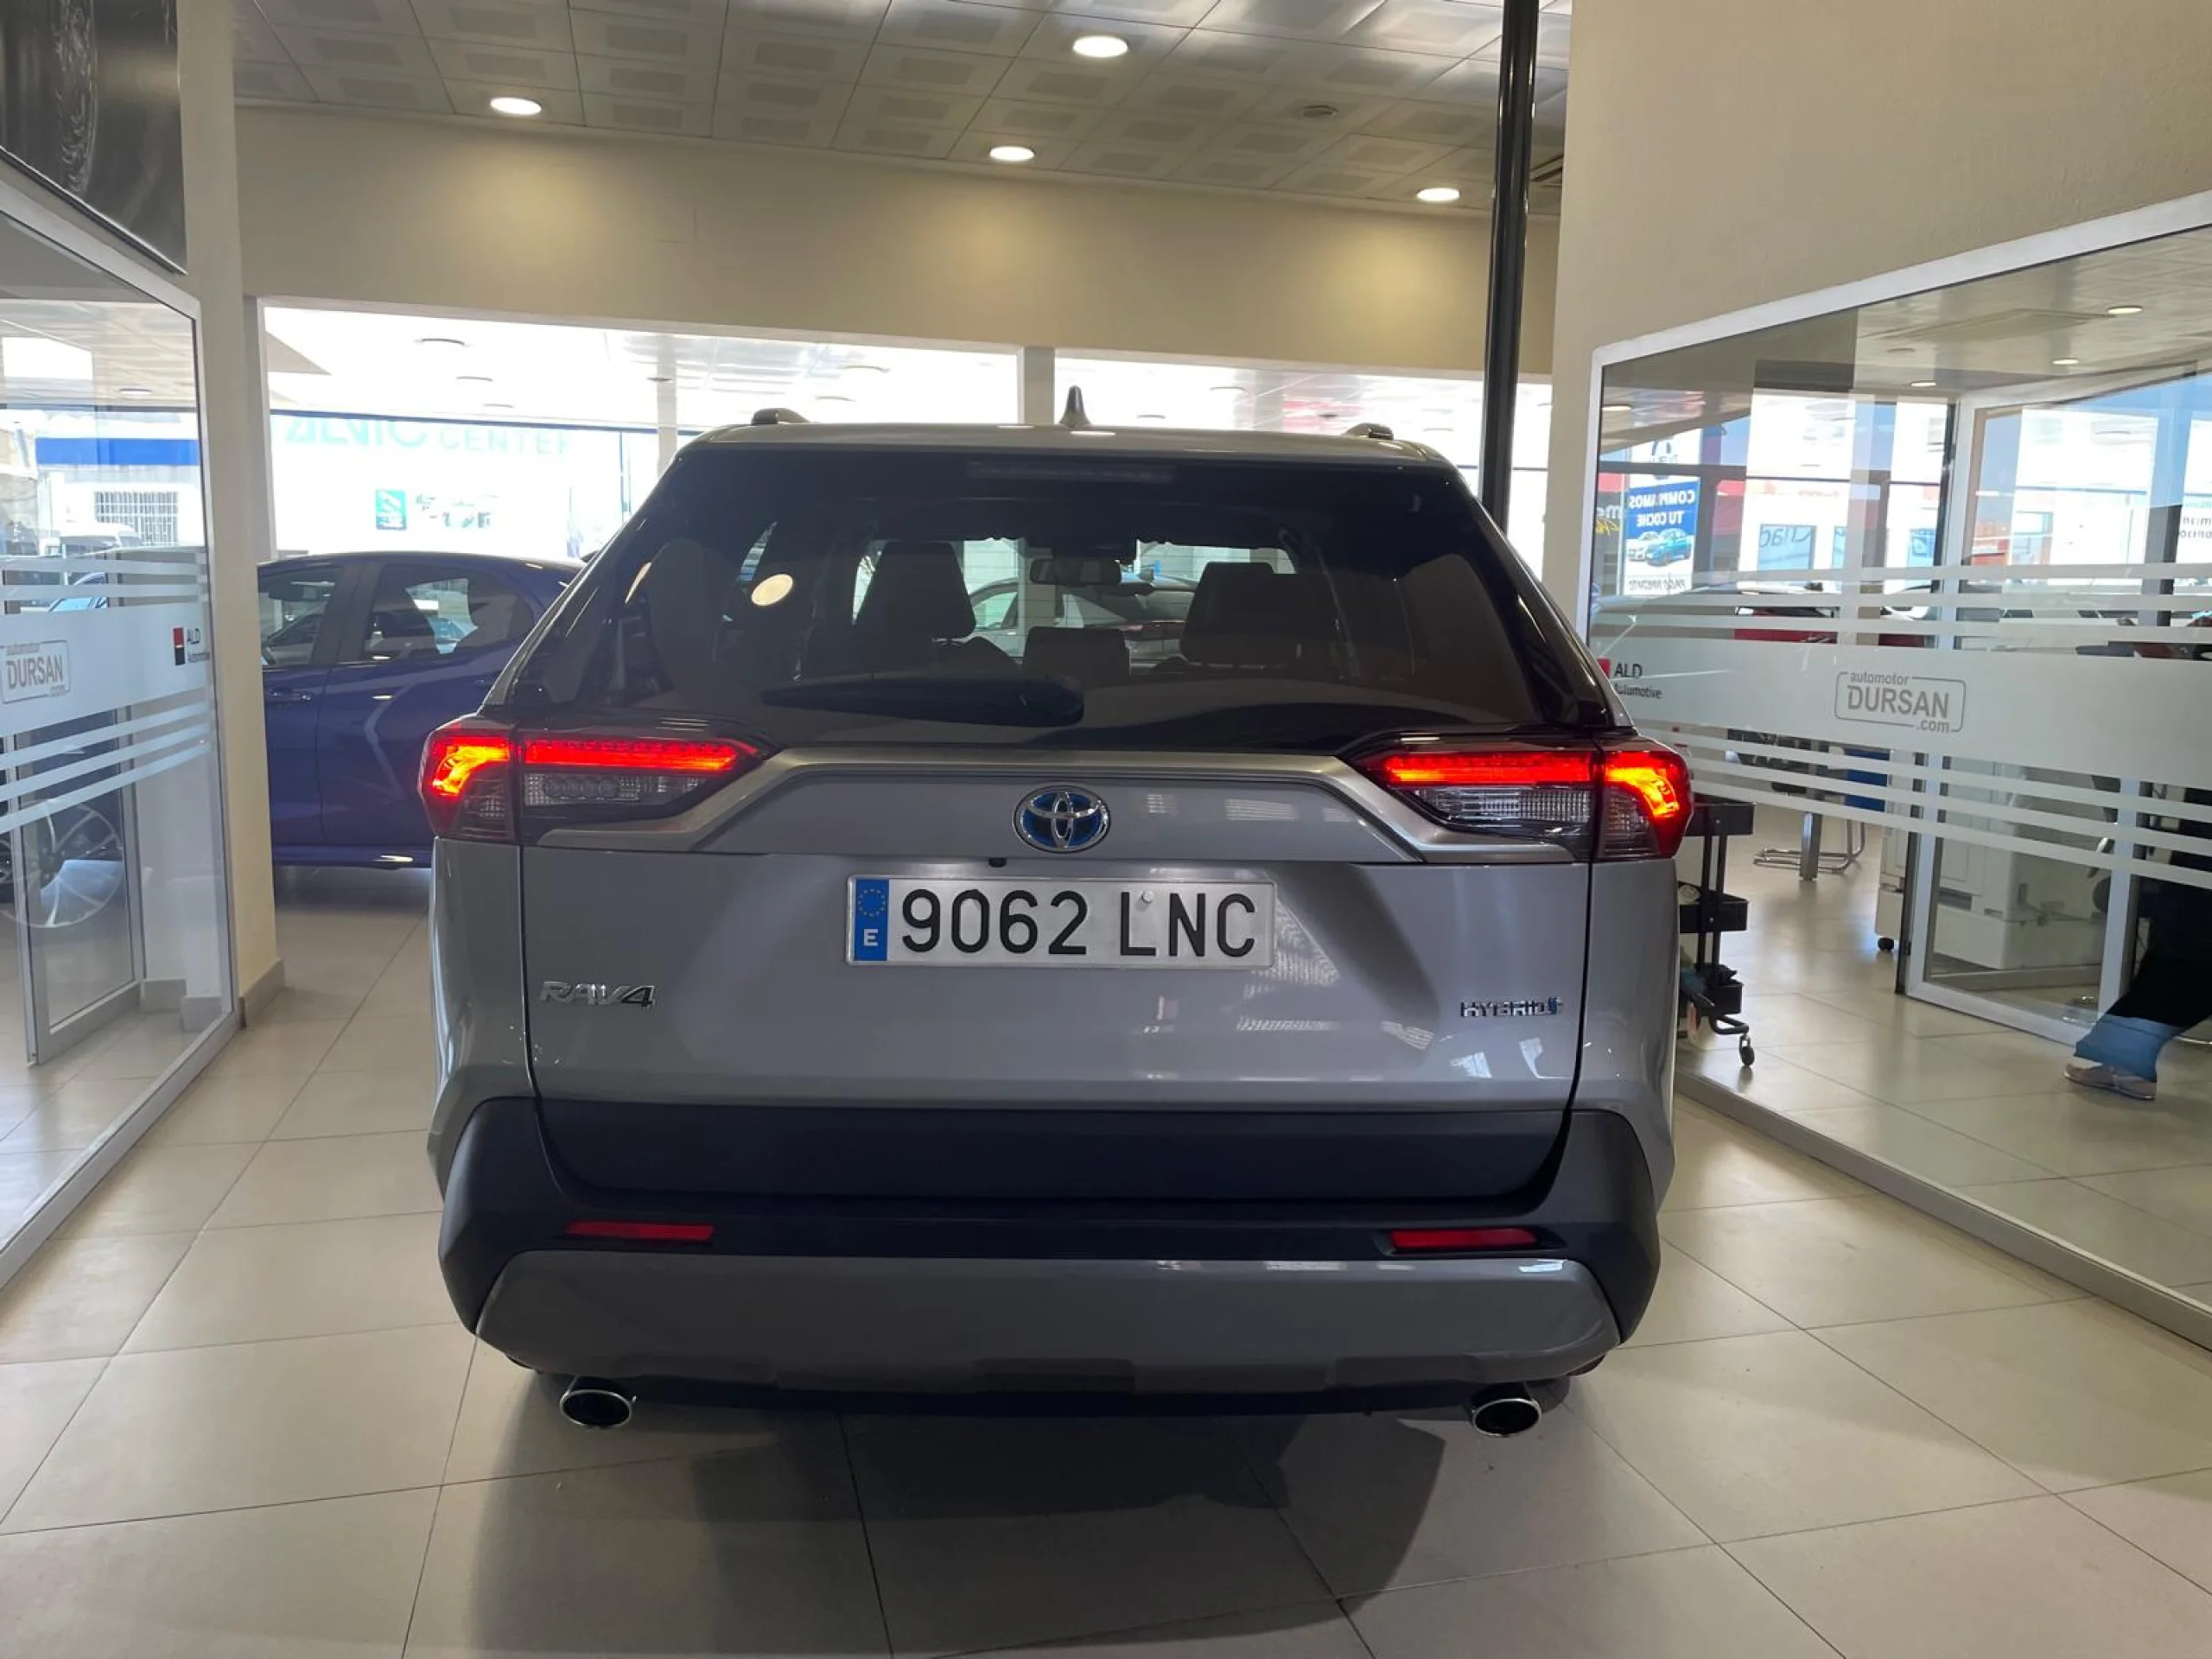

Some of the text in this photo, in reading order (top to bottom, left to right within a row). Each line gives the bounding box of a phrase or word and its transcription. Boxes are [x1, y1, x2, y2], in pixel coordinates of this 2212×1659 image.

[6, 654, 64, 690] DURSAN
[1614, 662, 1643, 678] ALD
[1850, 671, 1910, 686] automotor
[1847, 685, 1950, 719] DURSAN
[1916, 719, 1950, 734] .com
[901, 888, 1256, 958] 9062 LNC
[863, 928, 879, 947] E
[540, 981, 656, 1007] RAV4
